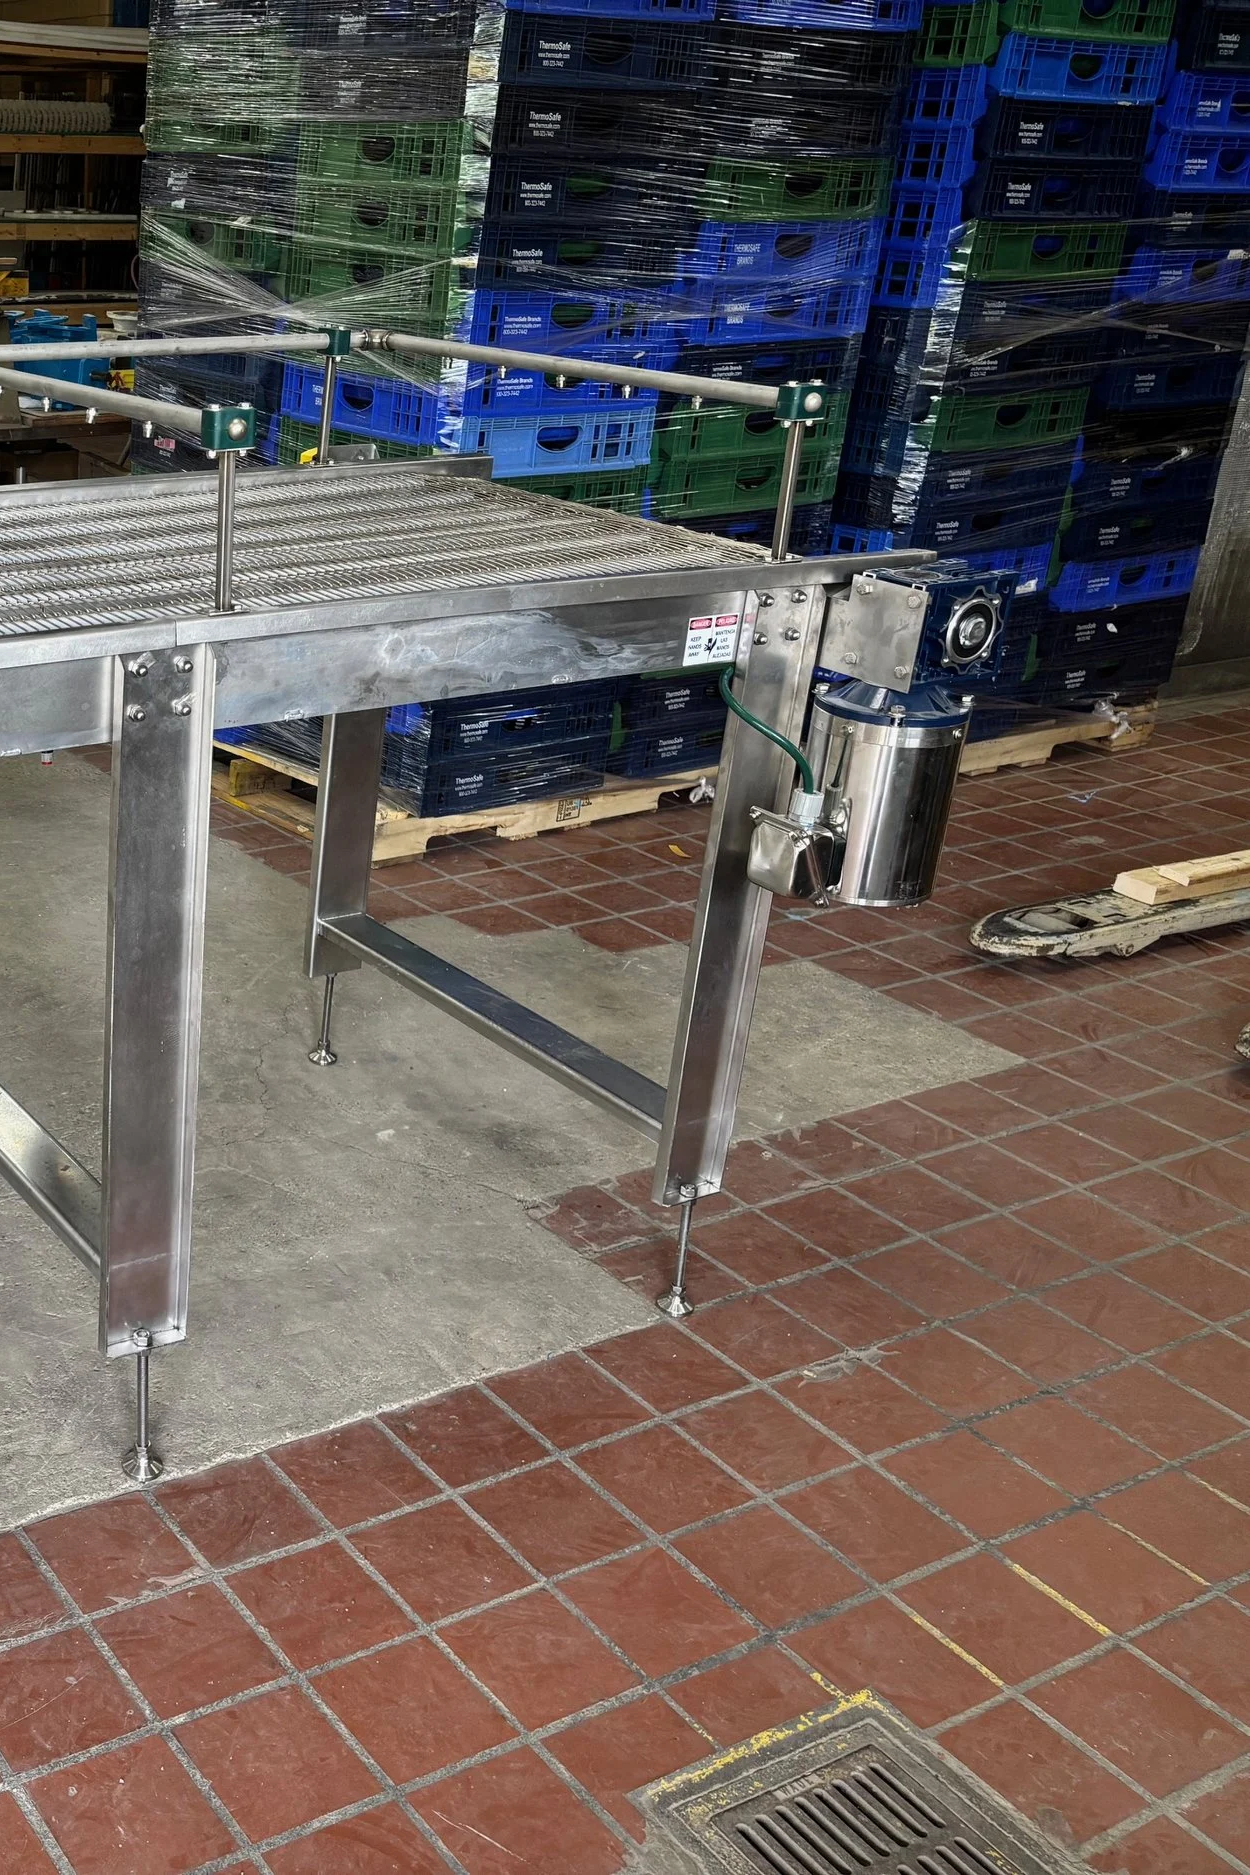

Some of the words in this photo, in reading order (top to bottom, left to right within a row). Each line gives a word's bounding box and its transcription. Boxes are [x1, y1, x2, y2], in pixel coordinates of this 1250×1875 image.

[539, 40, 571, 50] ThermoSafe
[530, 111, 561, 121] ThermoSafe
[1019, 122, 1044, 130] ThermoSafe
[521, 182, 552, 191] ThermoSafe
[1008, 182, 1031, 190] ThermoSafe
[512, 249, 543, 257] ThermoSafe
[734, 244, 761, 253] THERMOSAFE
[737, 256, 754, 265] BRANDS
[726, 315, 744, 325] BRANDS
[936, 521, 959, 529] ThermoSafe
[665, 688, 690, 698] ThermoSafe
[460, 721, 489, 730] ThermoSafe
[659, 736, 683, 746] ThermoSafe
[456, 774, 484, 785] ThermoSafe
